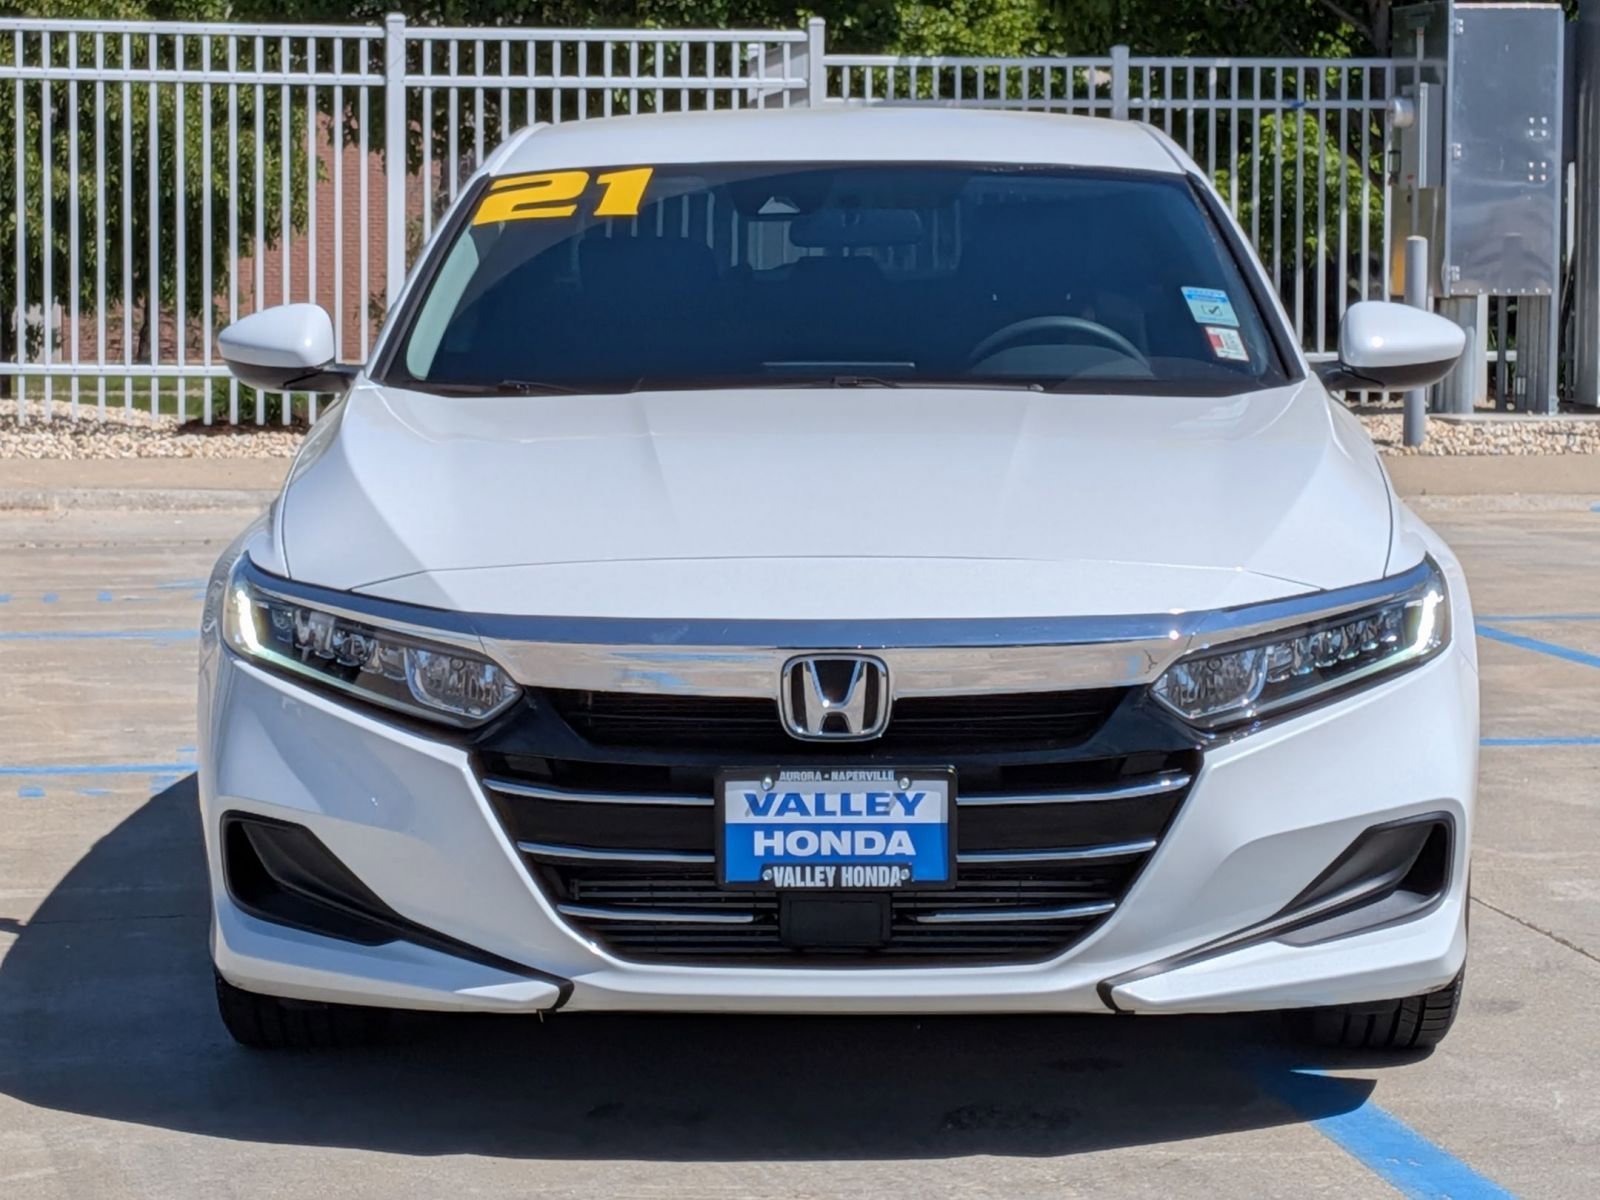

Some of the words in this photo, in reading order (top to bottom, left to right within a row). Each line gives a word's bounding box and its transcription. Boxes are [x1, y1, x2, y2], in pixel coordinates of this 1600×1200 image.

[472, 167, 654, 226] 21
[778, 770, 822, 781] AURORA
[831, 770, 895, 781] NAPERVILLE
[743, 792, 926, 817] VALLEY
[753, 830, 917, 856] HONDA
[772, 866, 836, 887] VALLEY
[841, 866, 901, 887] HONDA
